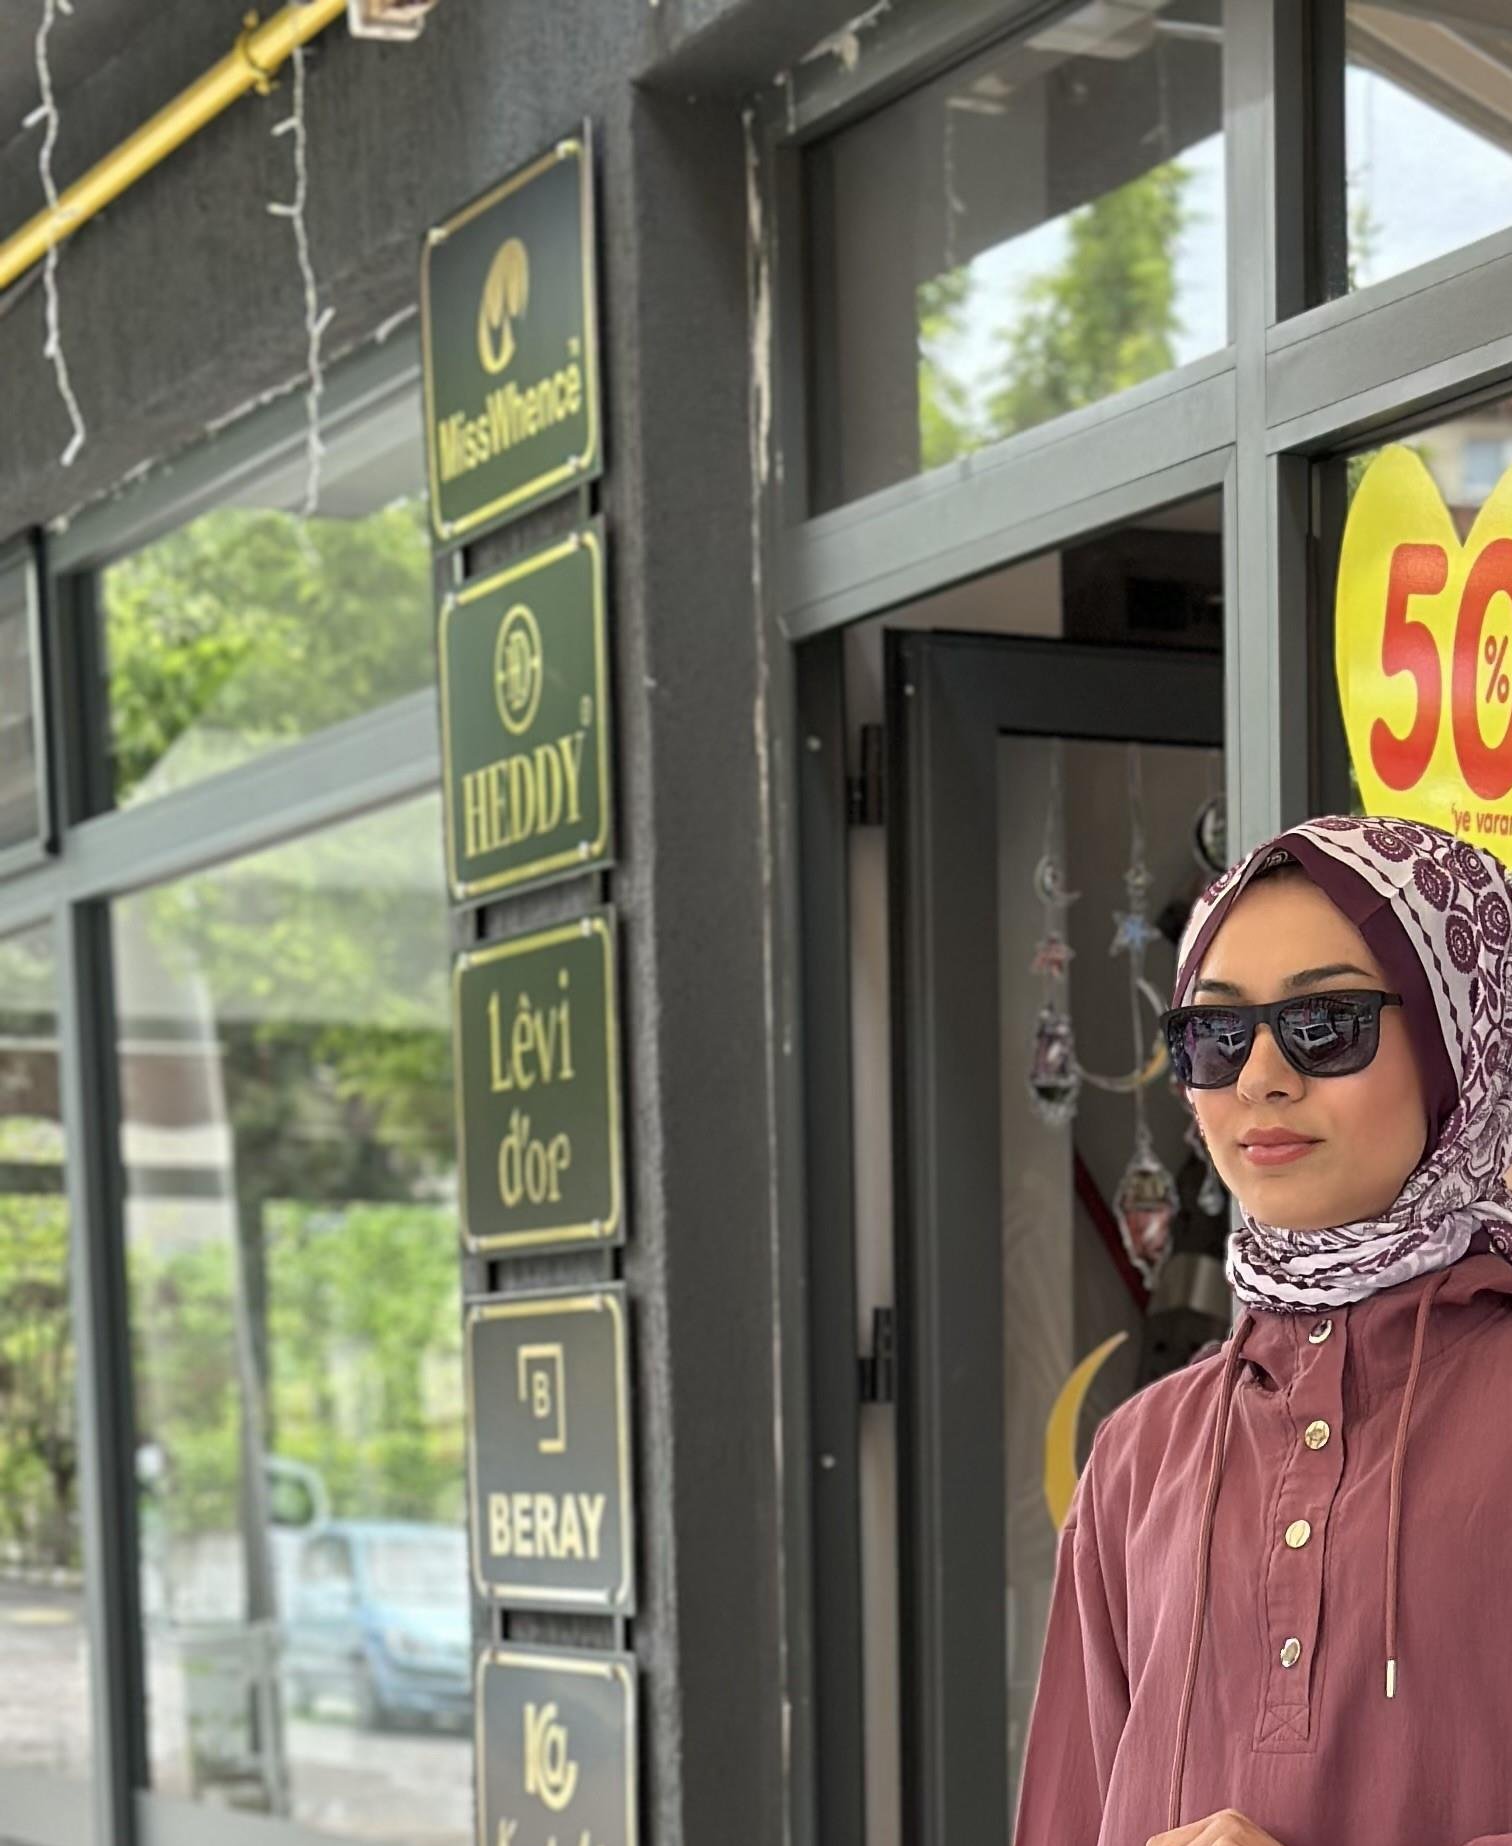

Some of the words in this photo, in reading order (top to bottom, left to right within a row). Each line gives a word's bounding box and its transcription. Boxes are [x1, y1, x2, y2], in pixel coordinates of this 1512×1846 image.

[438, 362, 582, 483] MissWhence
[462, 730, 586, 859] HEDDY
[499, 1106, 572, 1208] d'or
[488, 1491, 607, 1562] BERAY
